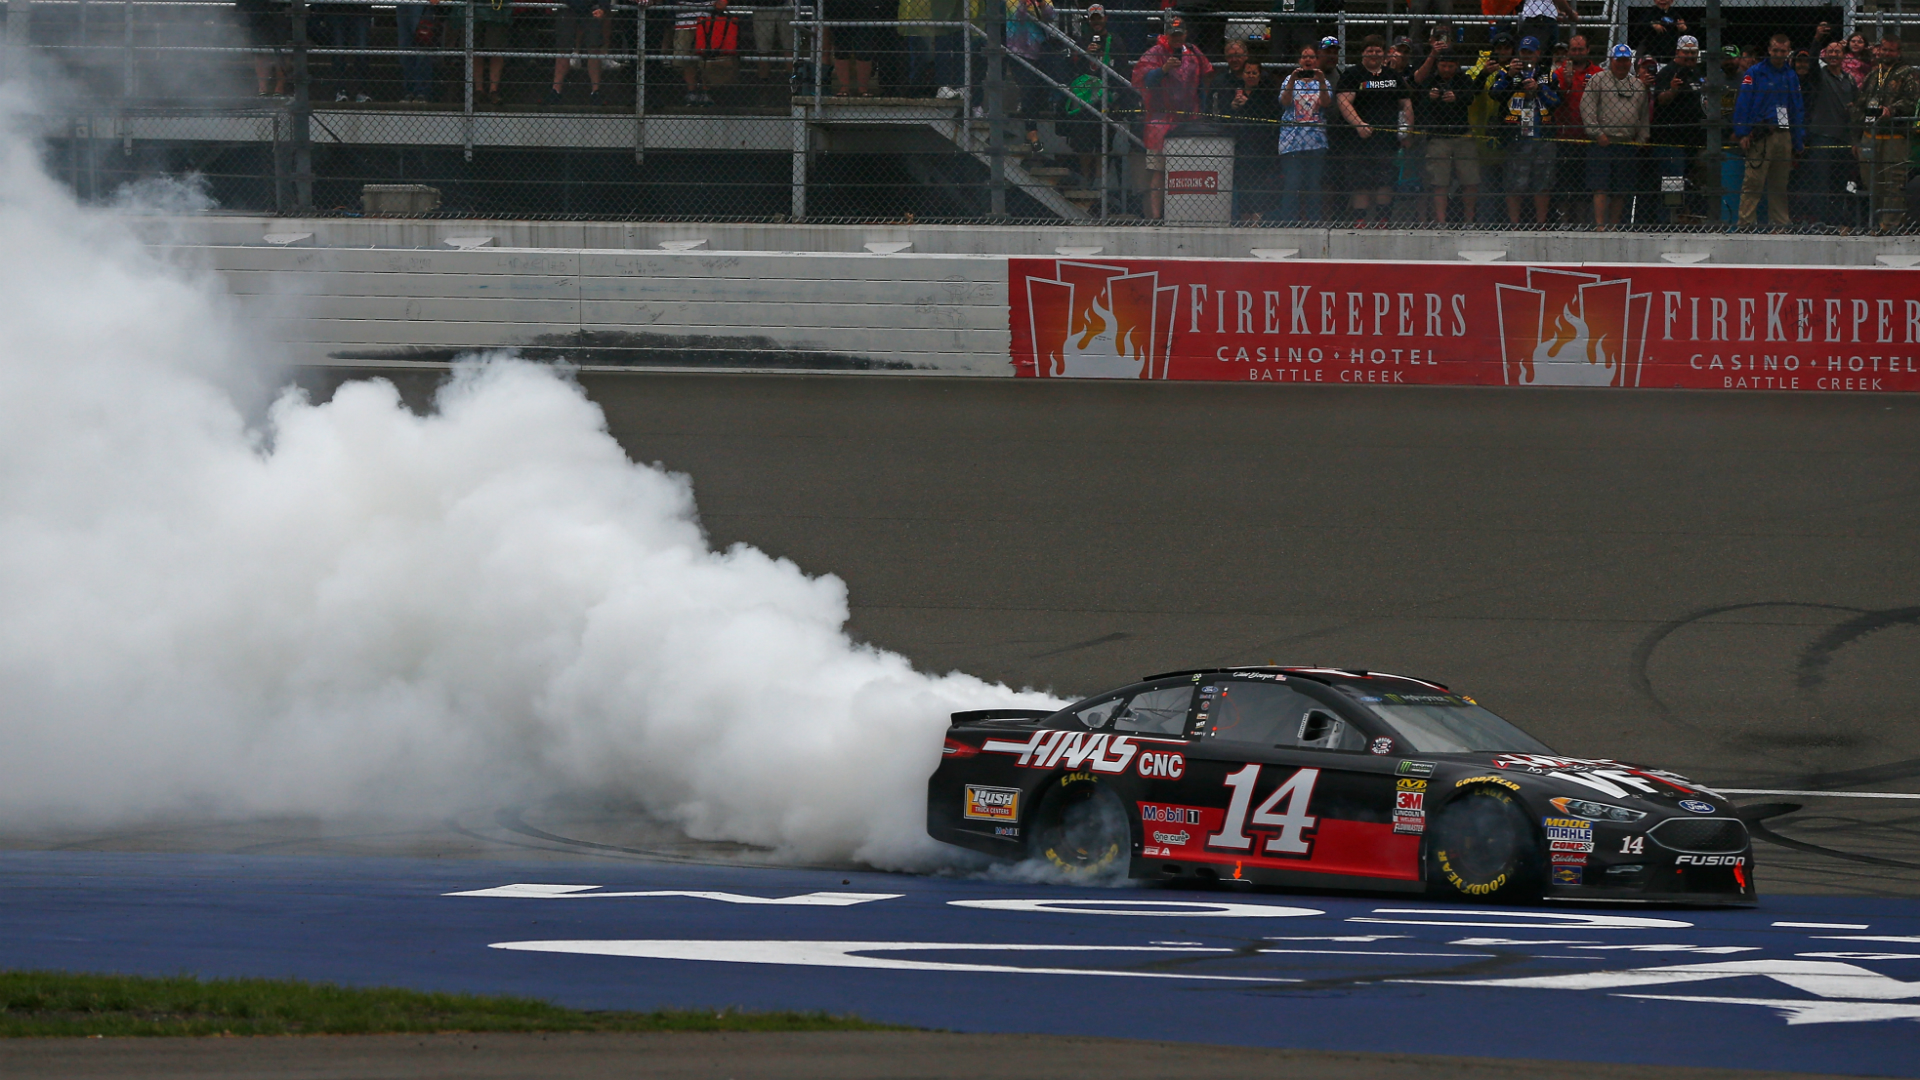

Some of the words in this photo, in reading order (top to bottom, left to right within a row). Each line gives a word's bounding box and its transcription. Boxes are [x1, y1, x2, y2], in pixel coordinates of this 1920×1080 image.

[1188, 283, 1466, 338] FIREKEEPERS
[1216, 346, 1323, 363] CASINO
[1350, 348, 1438, 366] HOTEL
[1690, 354, 1800, 371] CASINO
[1828, 355, 1917, 373] HOTEL
[1250, 368, 1323, 382] BATTLE
[1340, 369, 1404, 383] CREEK
[1724, 376, 1799, 390] BATTLE
[1816, 377, 1882, 391] CREEK
[983, 729, 1138, 773] HAAS
[1138, 753, 1183, 778] CNC
[1061, 772, 1099, 787] EAGLE
[1455, 776, 1521, 791] GOODYEAR
[1397, 793, 1422, 810] 3M
[1474, 787, 1512, 805] EAGLE
[975, 806, 990, 814] TRUCK
[990, 807, 1009, 815] CENTERS
[1208, 763, 1321, 854] 14
[1685, 800, 1711, 811] Ford
[1143, 804, 1184, 823] Mobil
[995, 826, 1013, 835] Mobil
[1544, 818, 1591, 828] MOOG
[1548, 828, 1591, 840] MAHLE
[1552, 841, 1583, 849] COMP
[1619, 836, 1644, 854] 14
[1551, 854, 1587, 864] Edelbrock
[1675, 855, 1746, 866] FUSION
[1438, 850, 1506, 895] GOODYEAR
